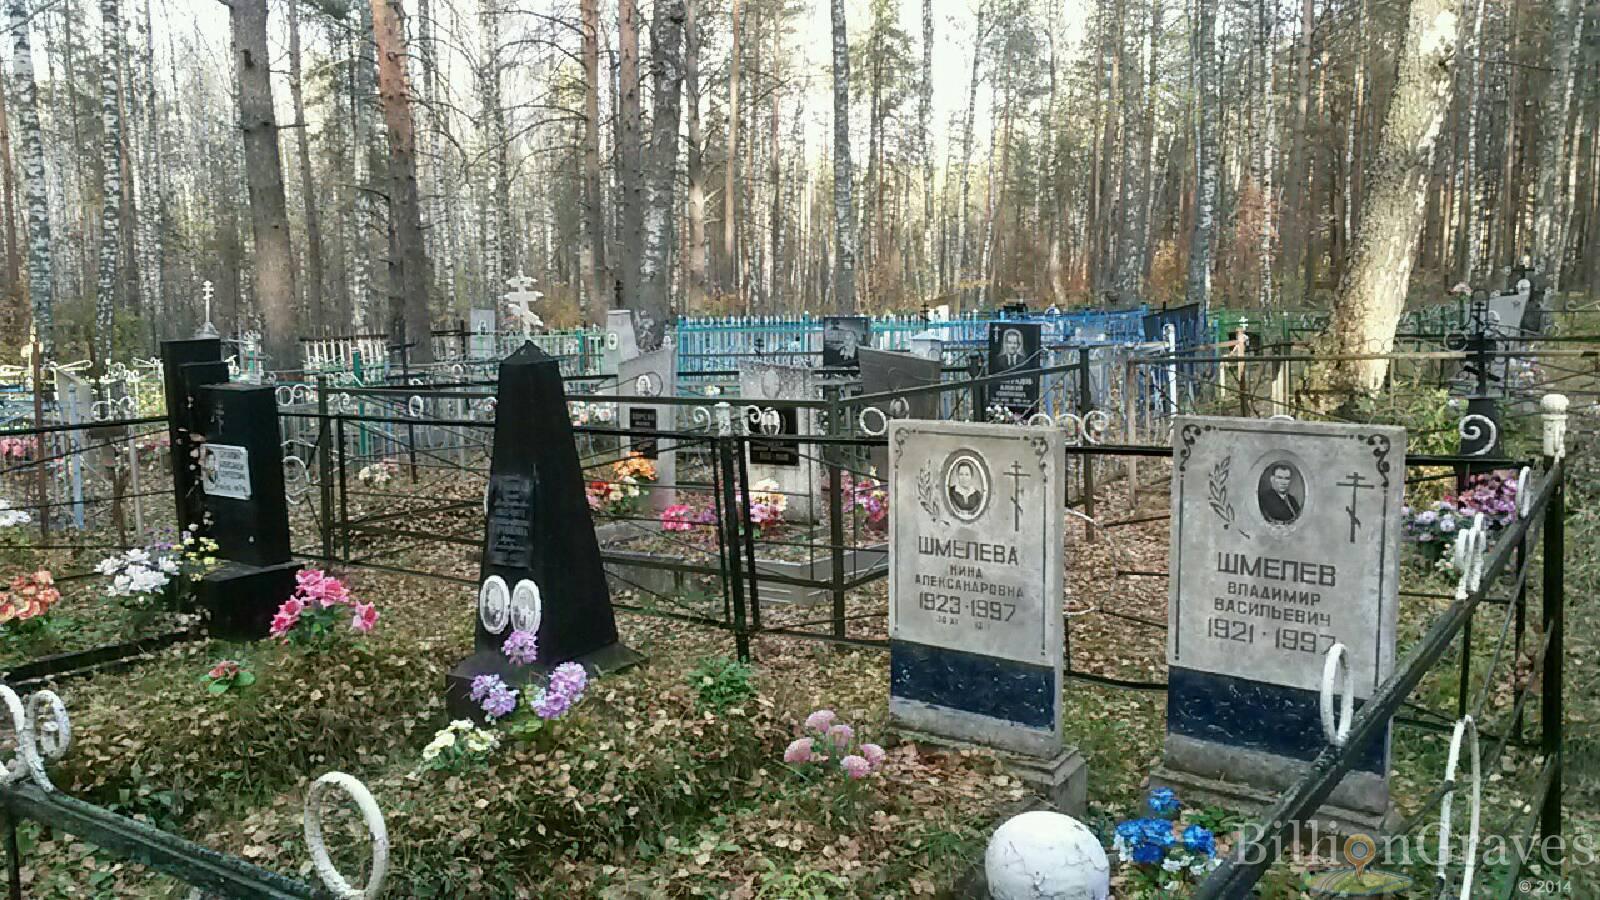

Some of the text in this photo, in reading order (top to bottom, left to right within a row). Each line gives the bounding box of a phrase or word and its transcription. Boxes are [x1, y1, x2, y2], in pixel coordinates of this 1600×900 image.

[918, 535, 1019, 565] ШМЕЛЕВА
[1217, 551, 1336, 587] ШМЕЛЕВ
[915, 574, 1024, 598] АЛЕКСАНДРОВНА
[1227, 581, 1321, 606] ВЛАДИМИР
[919, 592, 961, 615] 1923
[970, 599, 1016, 622] 1997
[1214, 597, 1331, 627] ВАСИЛЬЕВИЧ
[1207, 617, 1254, 644] 1921
[1275, 627, 1336, 655] 1997
